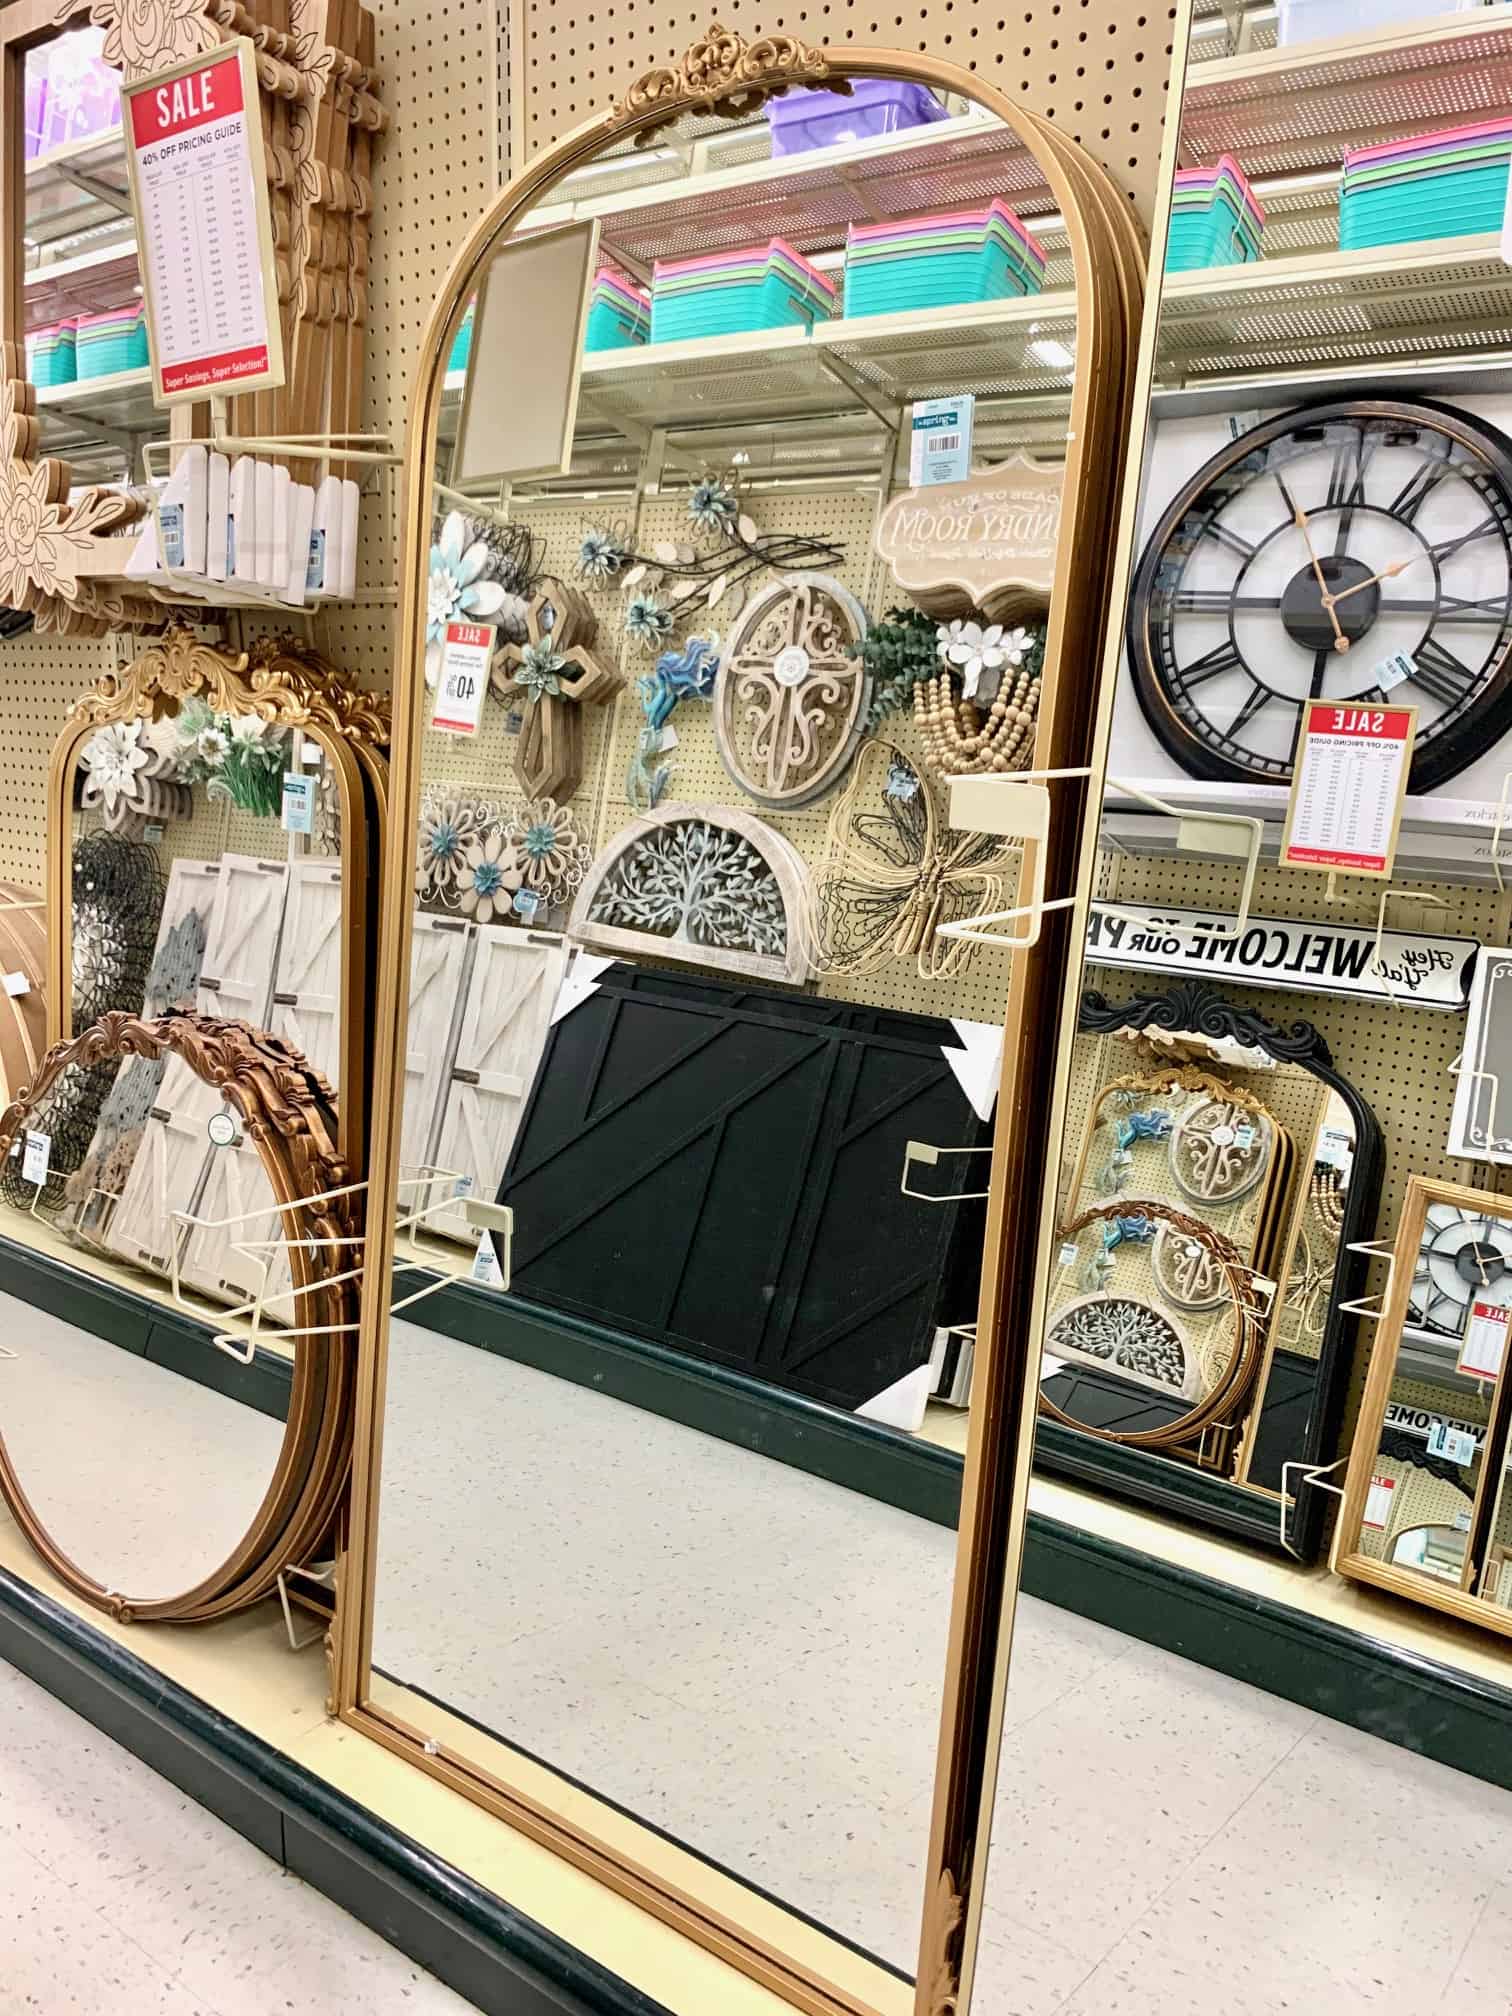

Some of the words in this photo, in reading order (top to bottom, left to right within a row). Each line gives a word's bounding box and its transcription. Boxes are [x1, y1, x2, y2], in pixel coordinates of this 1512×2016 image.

[156, 70, 215, 128] SALE
[142, 152, 159, 166] 40%
[160, 144, 177, 160] OFF
[178, 131, 213, 153] PRICING
[214, 121, 242, 141] GUIDE
